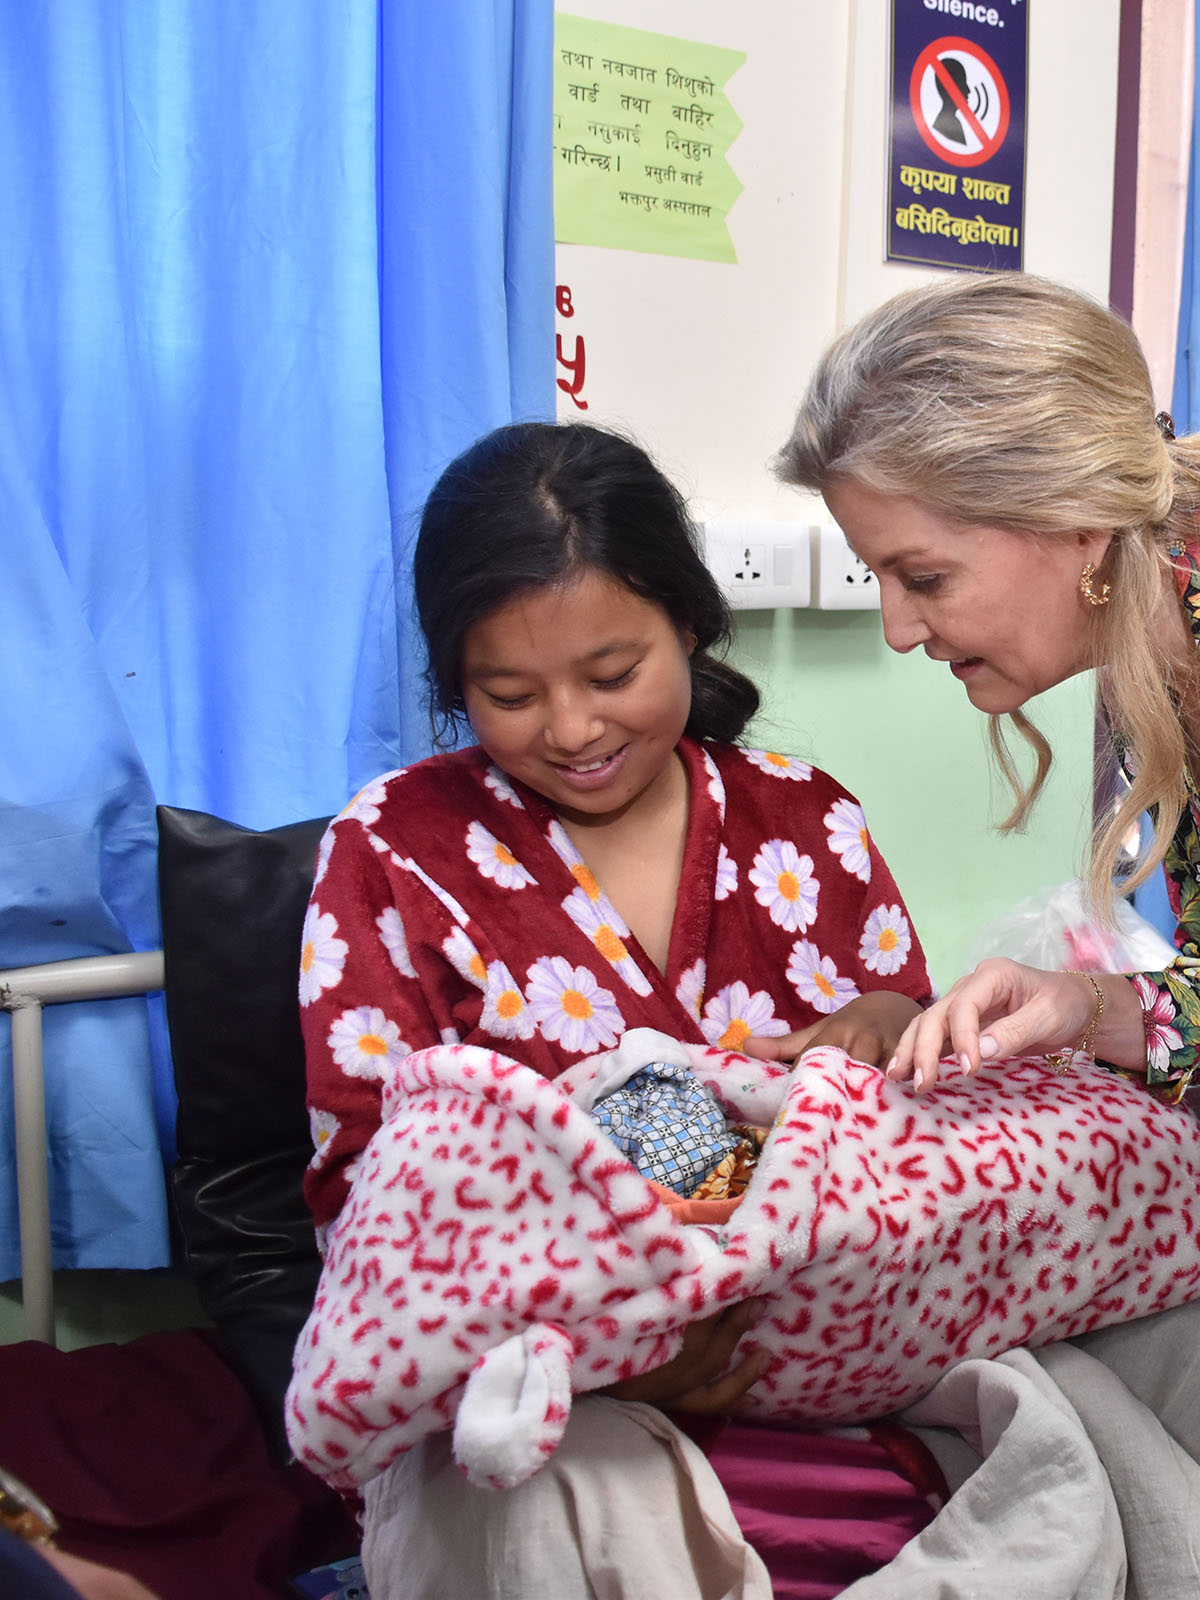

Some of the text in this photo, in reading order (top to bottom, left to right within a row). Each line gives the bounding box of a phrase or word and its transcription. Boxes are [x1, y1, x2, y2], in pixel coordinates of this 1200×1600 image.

[561, 49, 716, 98] तथा नवजात शिशुको
[568, 82, 600, 103] वार्ड
[620, 94, 651, 115] तथा
[665, 130, 712, 162] दिनुहुन
[900, 165, 1011, 205] कृपया शान्त
[619, 190, 711, 218] भक्तपुर अस्पताल
[895, 203, 1019, 248] बसिदिनुहोला।
